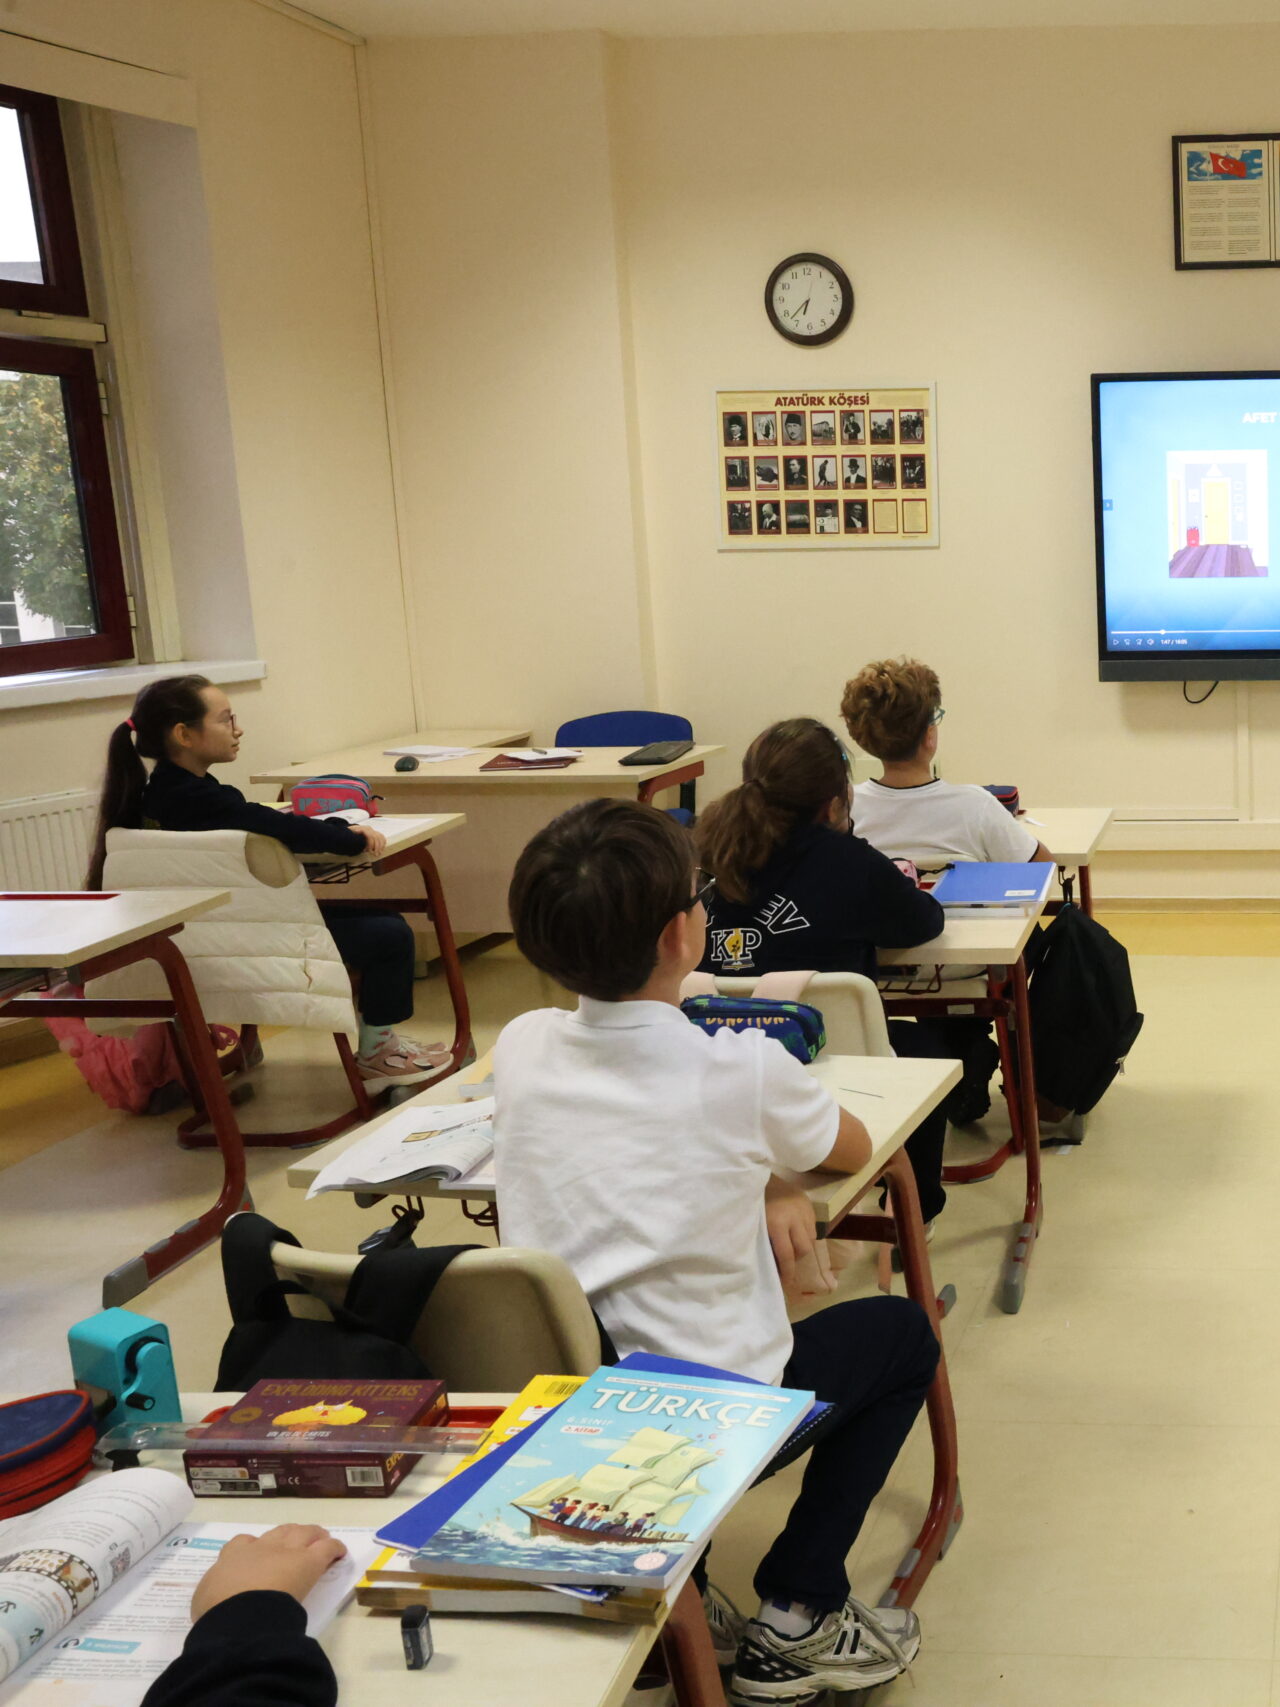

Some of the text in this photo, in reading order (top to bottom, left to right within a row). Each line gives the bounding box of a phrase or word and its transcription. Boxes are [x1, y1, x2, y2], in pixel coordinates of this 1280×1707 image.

[774, 393, 825, 407] ATATÜRK
[828, 393, 870, 408] KÖŞESİ
[1242, 412, 1278, 424] AFET
[261, 1384, 424, 1397] EXPLODING KITTENS
[592, 1386, 782, 1430] TÜRKÇE
